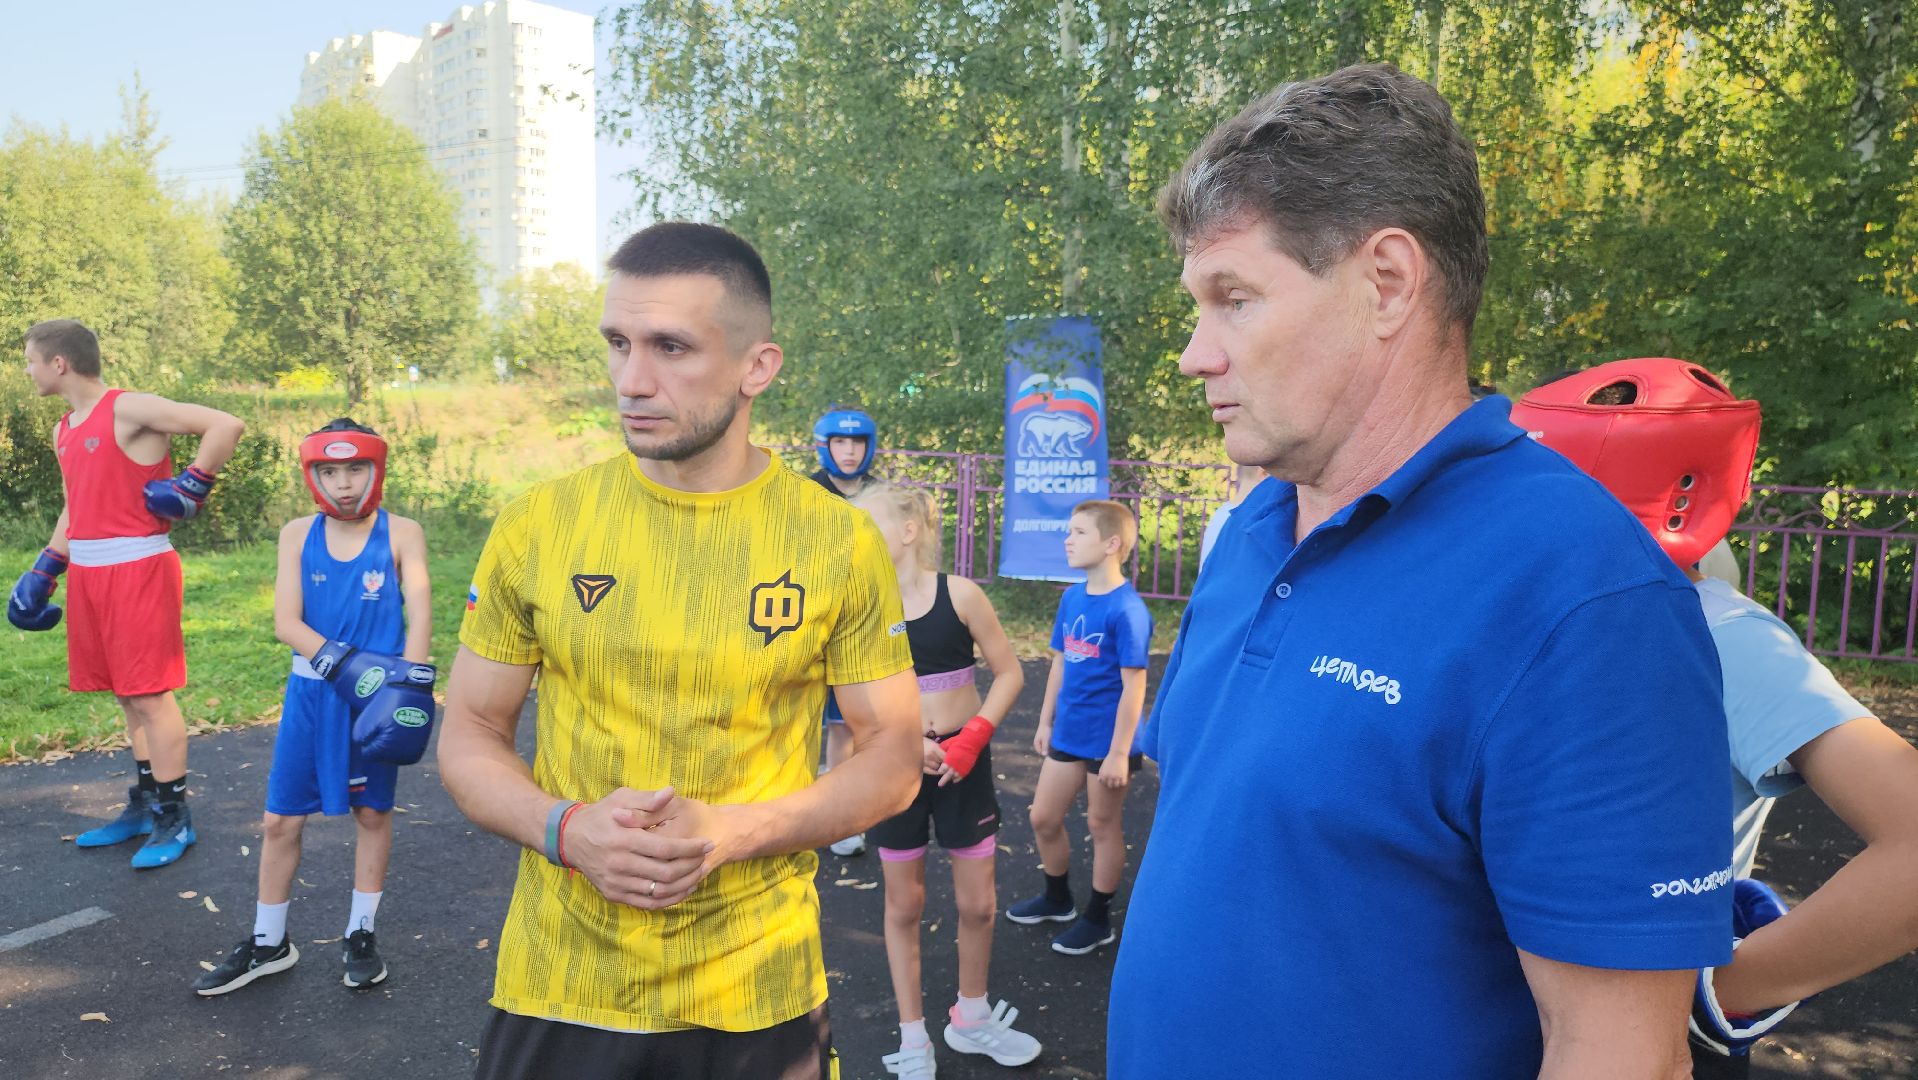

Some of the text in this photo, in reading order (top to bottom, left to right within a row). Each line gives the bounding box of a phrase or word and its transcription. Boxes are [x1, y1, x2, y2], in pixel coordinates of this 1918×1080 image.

[1014, 460, 1096, 476] ЕДИНАЯ
[1014, 477, 1097, 493] РОССИЯ
[1013, 519, 1069, 533] ДОЛГОПРУ
